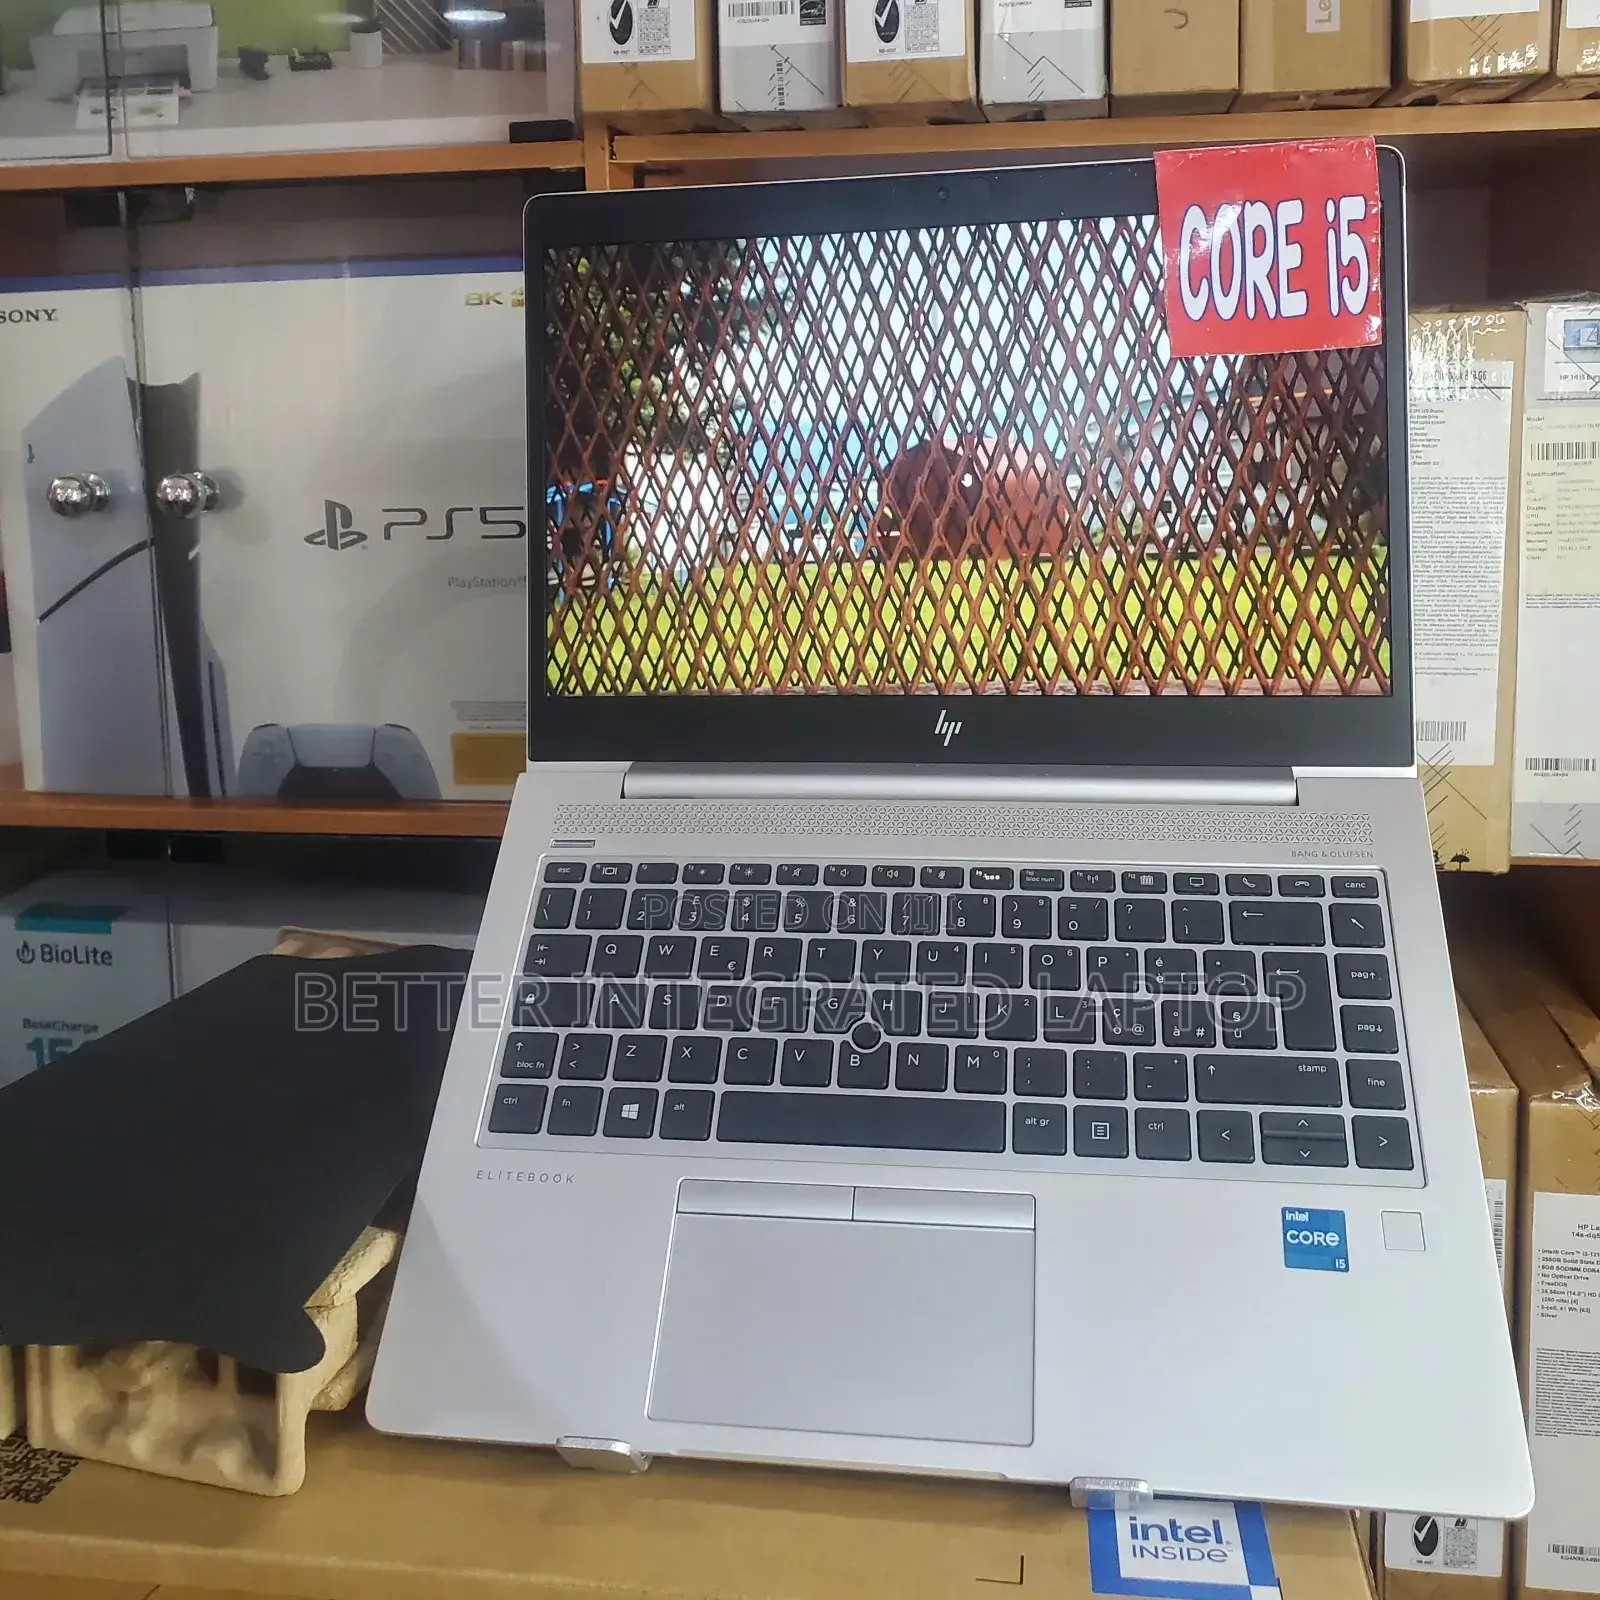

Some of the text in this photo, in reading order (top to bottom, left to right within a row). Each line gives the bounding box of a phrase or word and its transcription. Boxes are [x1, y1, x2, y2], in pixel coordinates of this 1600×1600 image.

[1179, 195, 1369, 321] CORE i5
[0, 308, 58, 324] SONY
[382, 506, 526, 540] PS5
[1291, 850, 1320, 858] BANG
[1345, 881, 1366, 889] canc
[742, 896, 751, 907] $
[795, 899, 806, 908] %
[849, 898, 857, 907] &
[1126, 904, 1133, 914] ?
[586, 910, 591, 921] 1
[636, 910, 645, 921] 2
[688, 911, 696, 922] 3
[741, 912, 749, 922] 4
[794, 914, 802, 923] 5
[847, 914, 856, 924] 6
[902, 916, 910, 926] 7
[957, 917, 966, 927] 8
[1012, 919, 1022, 929] 9
[40, 943, 113, 966] BioLite
[605, 943, 617, 955] Q
[658, 944, 675, 955] W
[709, 945, 720, 956] E
[764, 947, 774, 957] R
[817, 948, 826, 958] T
[873, 949, 884, 960] Y
[928, 945, 959, 962] U 4
[727, 961, 736, 970] €
[1041, 954, 1053, 966] O
[1098, 956, 1108, 967] P
[1155, 957, 1164, 967] é
[1156, 973, 1164, 984] è
[1350, 970, 1369, 981] pag
[609, 995, 620, 1005] A
[663, 994, 672, 1006] S
[716, 996, 727, 1007] D
[771, 997, 781, 1008] F
[827, 998, 839, 1009] G
[882, 1000, 893, 1011] H
[939, 1001, 948, 1014] J
[997, 1004, 1008, 1016] K
[1055, 1007, 1064, 1018] L
[1113, 1008, 1122, 1019] ç
[1131, 1023, 1145, 1035] @
[1172, 1025, 1205, 1037] à #
[1357, 1023, 1375, 1033] pag
[626, 1045, 637, 1057] Z
[681, 1046, 692, 1059] X
[737, 1048, 748, 1060] C
[794, 1049, 806, 1062] V
[516, 1060, 545, 1069] bloc fn
[850, 1054, 861, 1066] B
[908, 1053, 919, 1066] N
[967, 1056, 980, 1068] M
[1298, 1063, 1327, 1074] stamp
[1367, 1077, 1386, 1087] fine
[503, 1096, 518, 1105] ctrl
[562, 1099, 571, 1107] fn
[673, 1103, 685, 1111] alt
[1025, 1116, 1050, 1127] alt gr
[1148, 1121, 1164, 1131] ctrl
[476, 1170, 575, 1184] ELITEBOOK
[1129, 1515, 1224, 1545] intel
